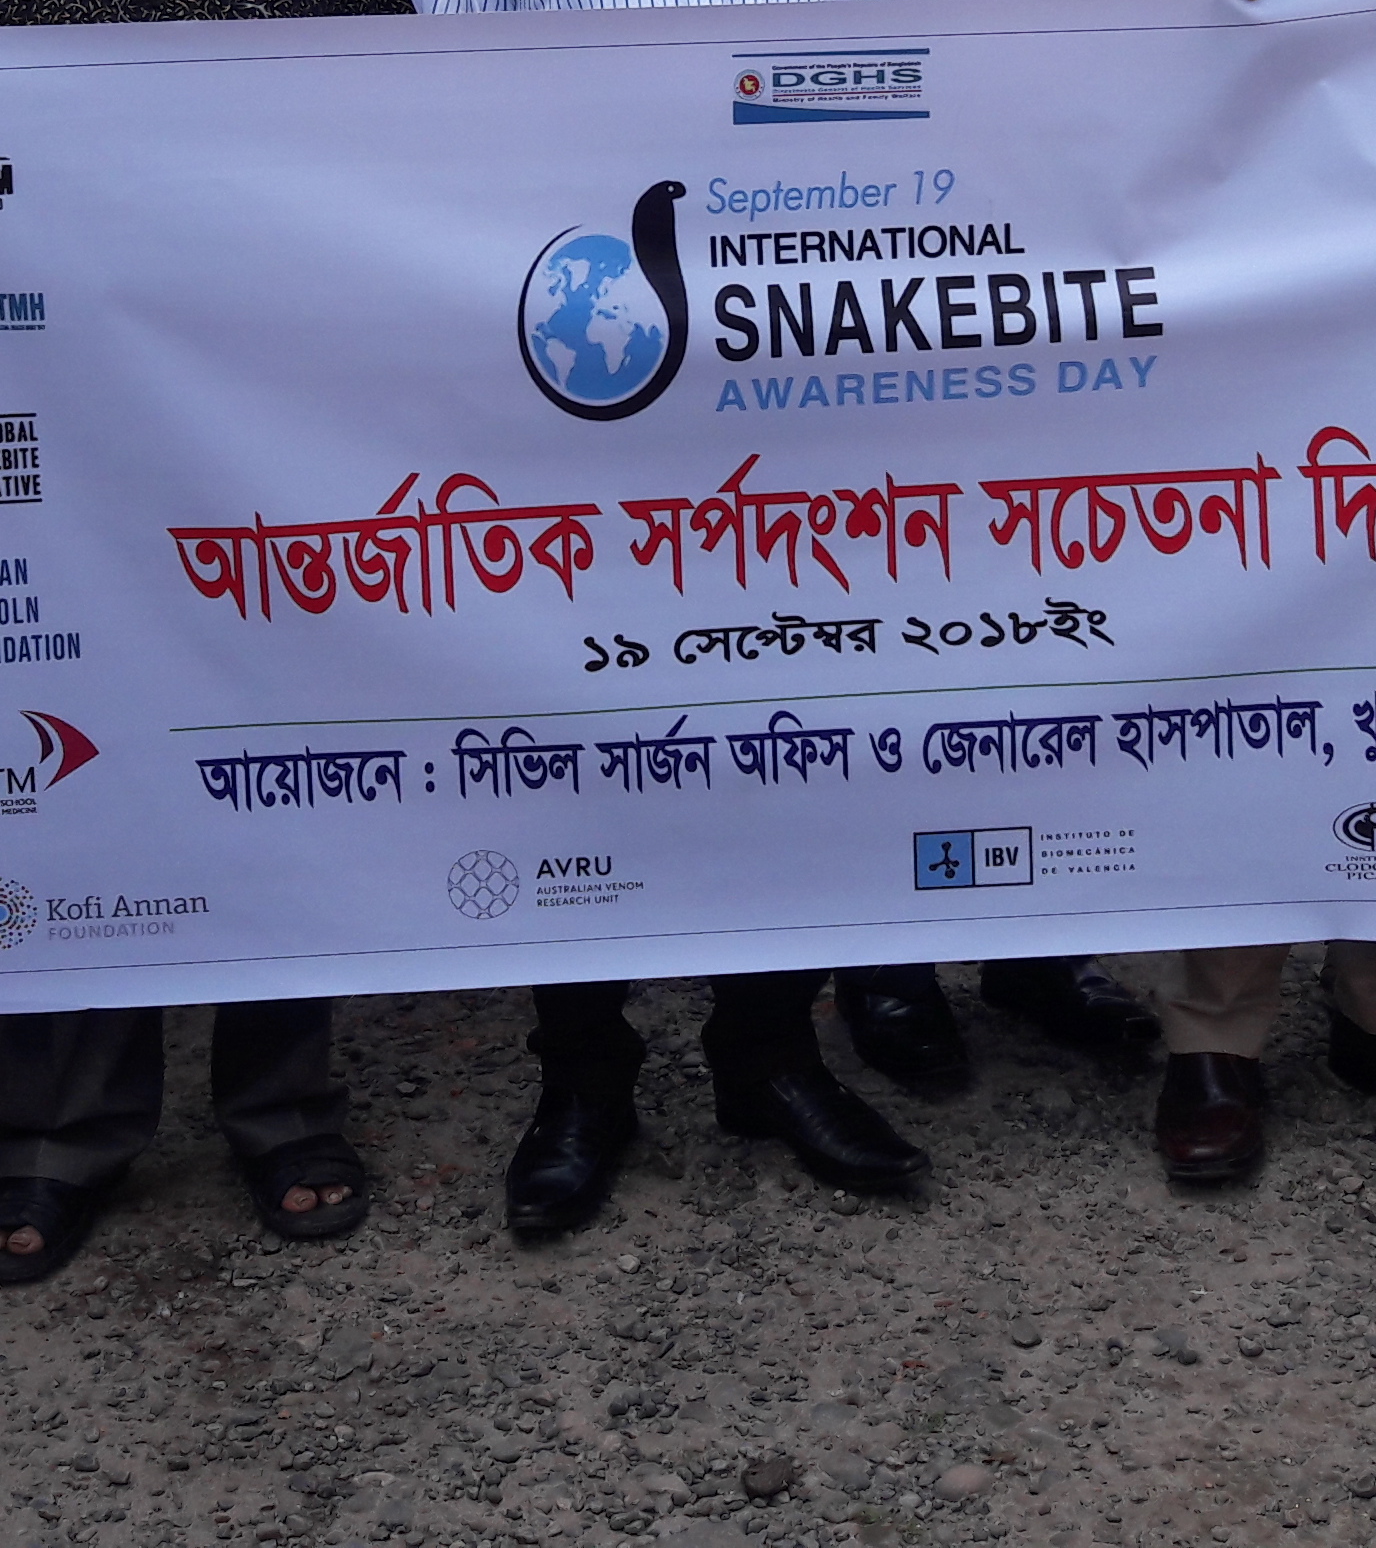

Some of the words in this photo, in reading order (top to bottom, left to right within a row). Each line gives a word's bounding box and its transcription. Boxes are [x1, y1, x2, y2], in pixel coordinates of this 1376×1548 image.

[773, 68, 922, 87] DGHS
[706, 172, 897, 222] September
[912, 168, 955, 205] 19
[709, 222, 1026, 268] INTERNATIONAL
[714, 267, 1164, 362] SNAKEBITE
[716, 362, 1037, 412] AWARENESS
[1056, 355, 1158, 394] DAY
[166, 472, 604, 623] আন্তর্জাতিক
[618, 454, 964, 596] সর্পদংশন
[978, 452, 1283, 577] সচেতনা
[582, 633, 650, 672] ১৯
[674, 610, 882, 665] সেপ্টেম্বর
[901, 597, 1115, 655] ২০১৮ইং
[450, 725, 583, 799] সিভিল
[595, 714, 716, 793] সার্জন
[726, 710, 855, 786] অফিস
[869, 726, 902, 774] ও
[923, 711, 1103, 776] জেনারেল
[1113, 694, 1333, 770] হাসপাতাল,
[536, 856, 612, 879] AVRU
[984, 847, 1019, 867] IBV
[536, 883, 602, 895] AUSTRALIAN
[605, 881, 644, 891] VENOM
[537, 896, 591, 907] RESEARCH
[595, 894, 619, 904] UNIT
[47, 897, 105, 922] Kofi
[111, 893, 210, 918] Annan
[48, 921, 176, 941] FOUNDATION
